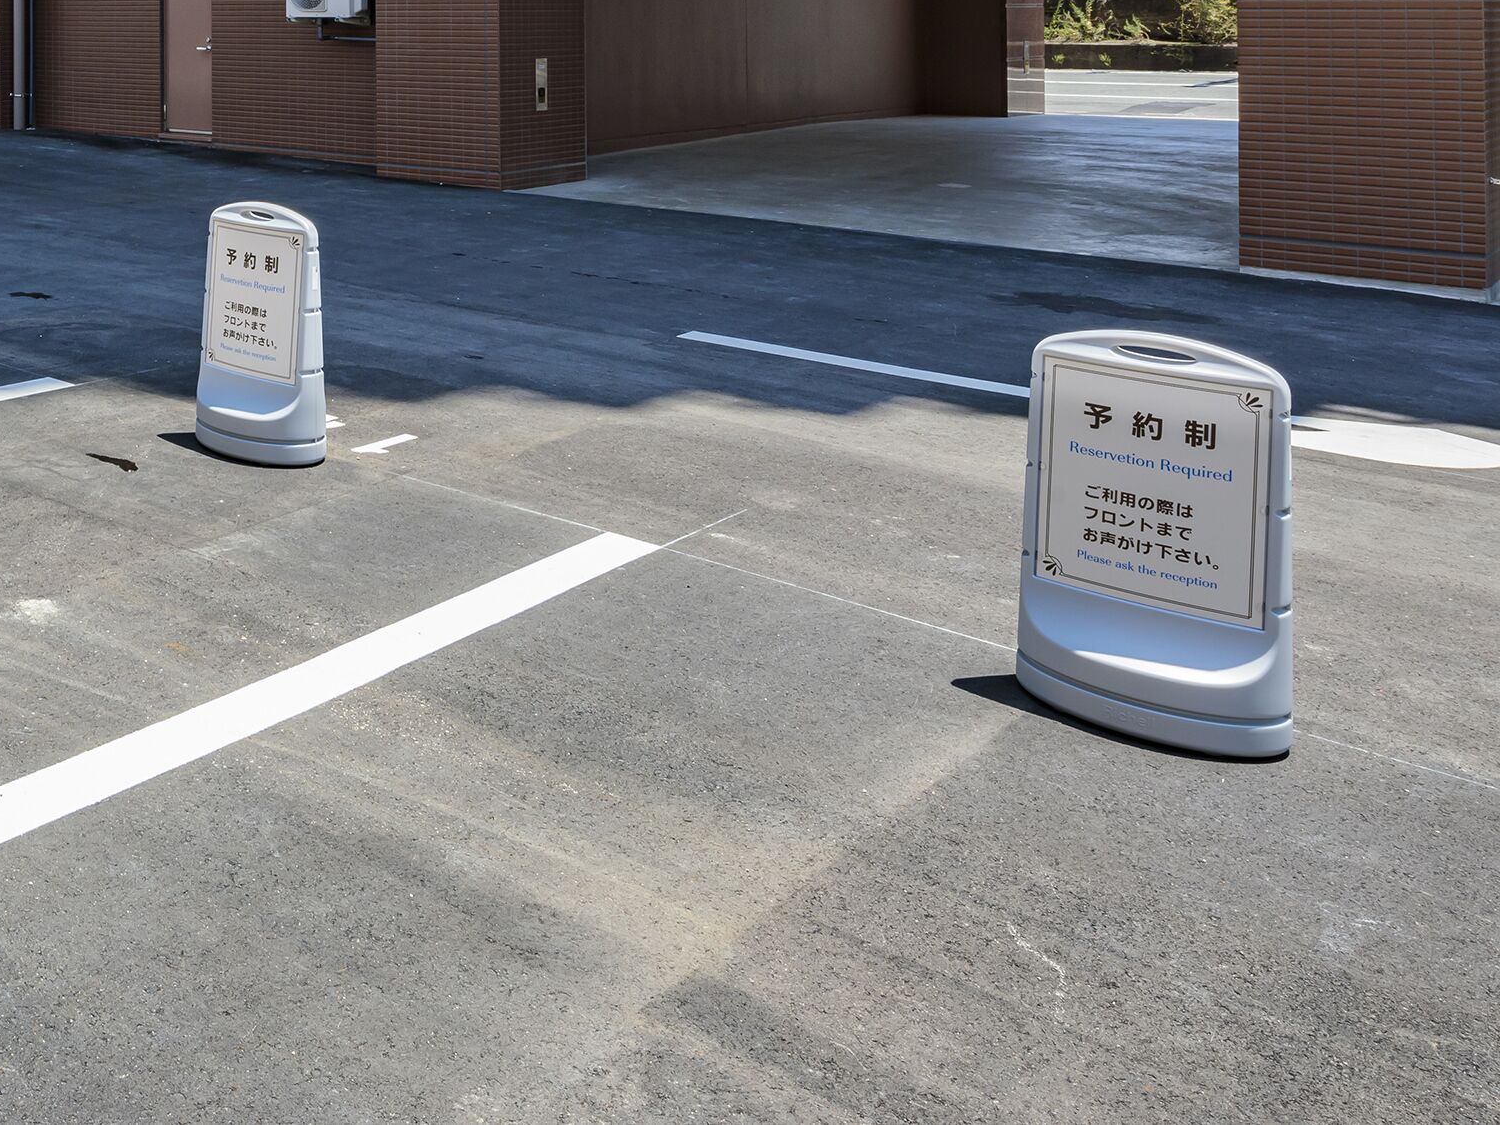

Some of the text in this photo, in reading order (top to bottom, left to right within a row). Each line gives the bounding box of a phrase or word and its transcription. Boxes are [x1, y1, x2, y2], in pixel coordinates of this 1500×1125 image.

[226, 248, 279, 274] 予約制
[253, 280, 285, 294] Required
[223, 314, 267, 333] フロントまで
[224, 300, 267, 318] ご利用の際は
[222, 328, 277, 350] お声がけ下さい。
[1083, 401, 1217, 451] 予約制
[1069, 440, 1233, 483] Reservetion Required
[1084, 484, 1194, 519] ご利用の際は
[1083, 505, 1193, 542] フロントまで
[1082, 527, 1220, 571] お声がけ下さい。
[1077, 548, 1218, 590] Please ask the reception
